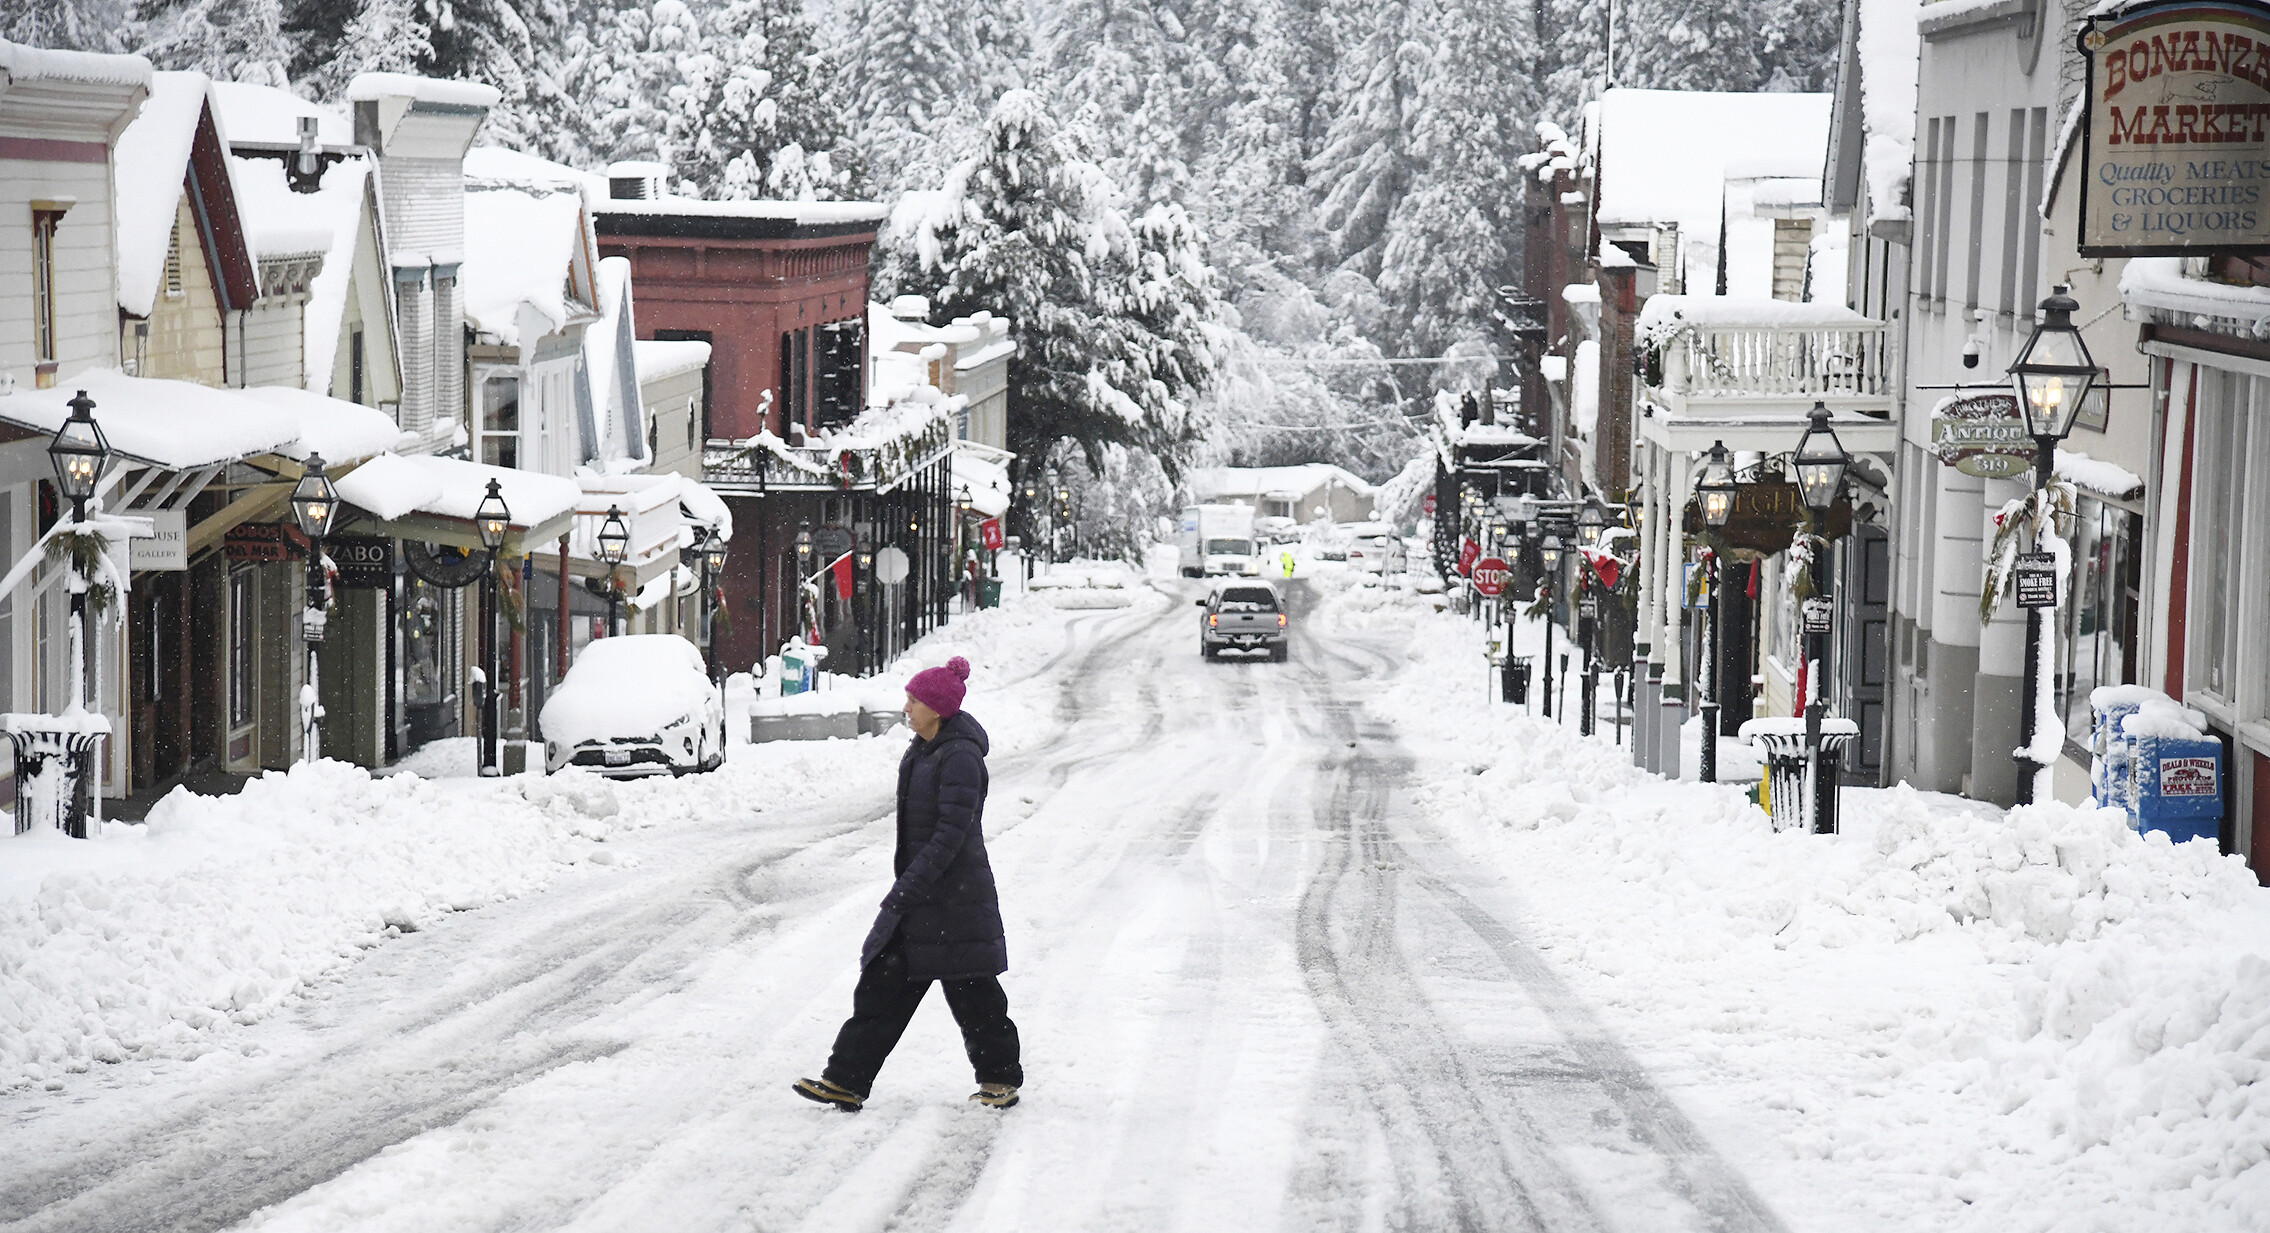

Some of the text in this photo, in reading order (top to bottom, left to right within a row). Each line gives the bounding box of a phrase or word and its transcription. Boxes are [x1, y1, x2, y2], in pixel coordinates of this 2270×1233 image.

[2103, 30, 2270, 103] BONANZA
[2109, 104, 2270, 144] MARKET
[2099, 160, 2270, 189] Quality MEATS
[2111, 186, 2260, 207] GROCERIES
[2111, 211, 2258, 234] & LIQUORS
[137, 550, 177, 558] GALLERY
[2019, 577, 2053, 588] SMOKE FREE
[2163, 760, 2182, 772] DEALS
[2189, 759, 2215, 771] WHEELS
